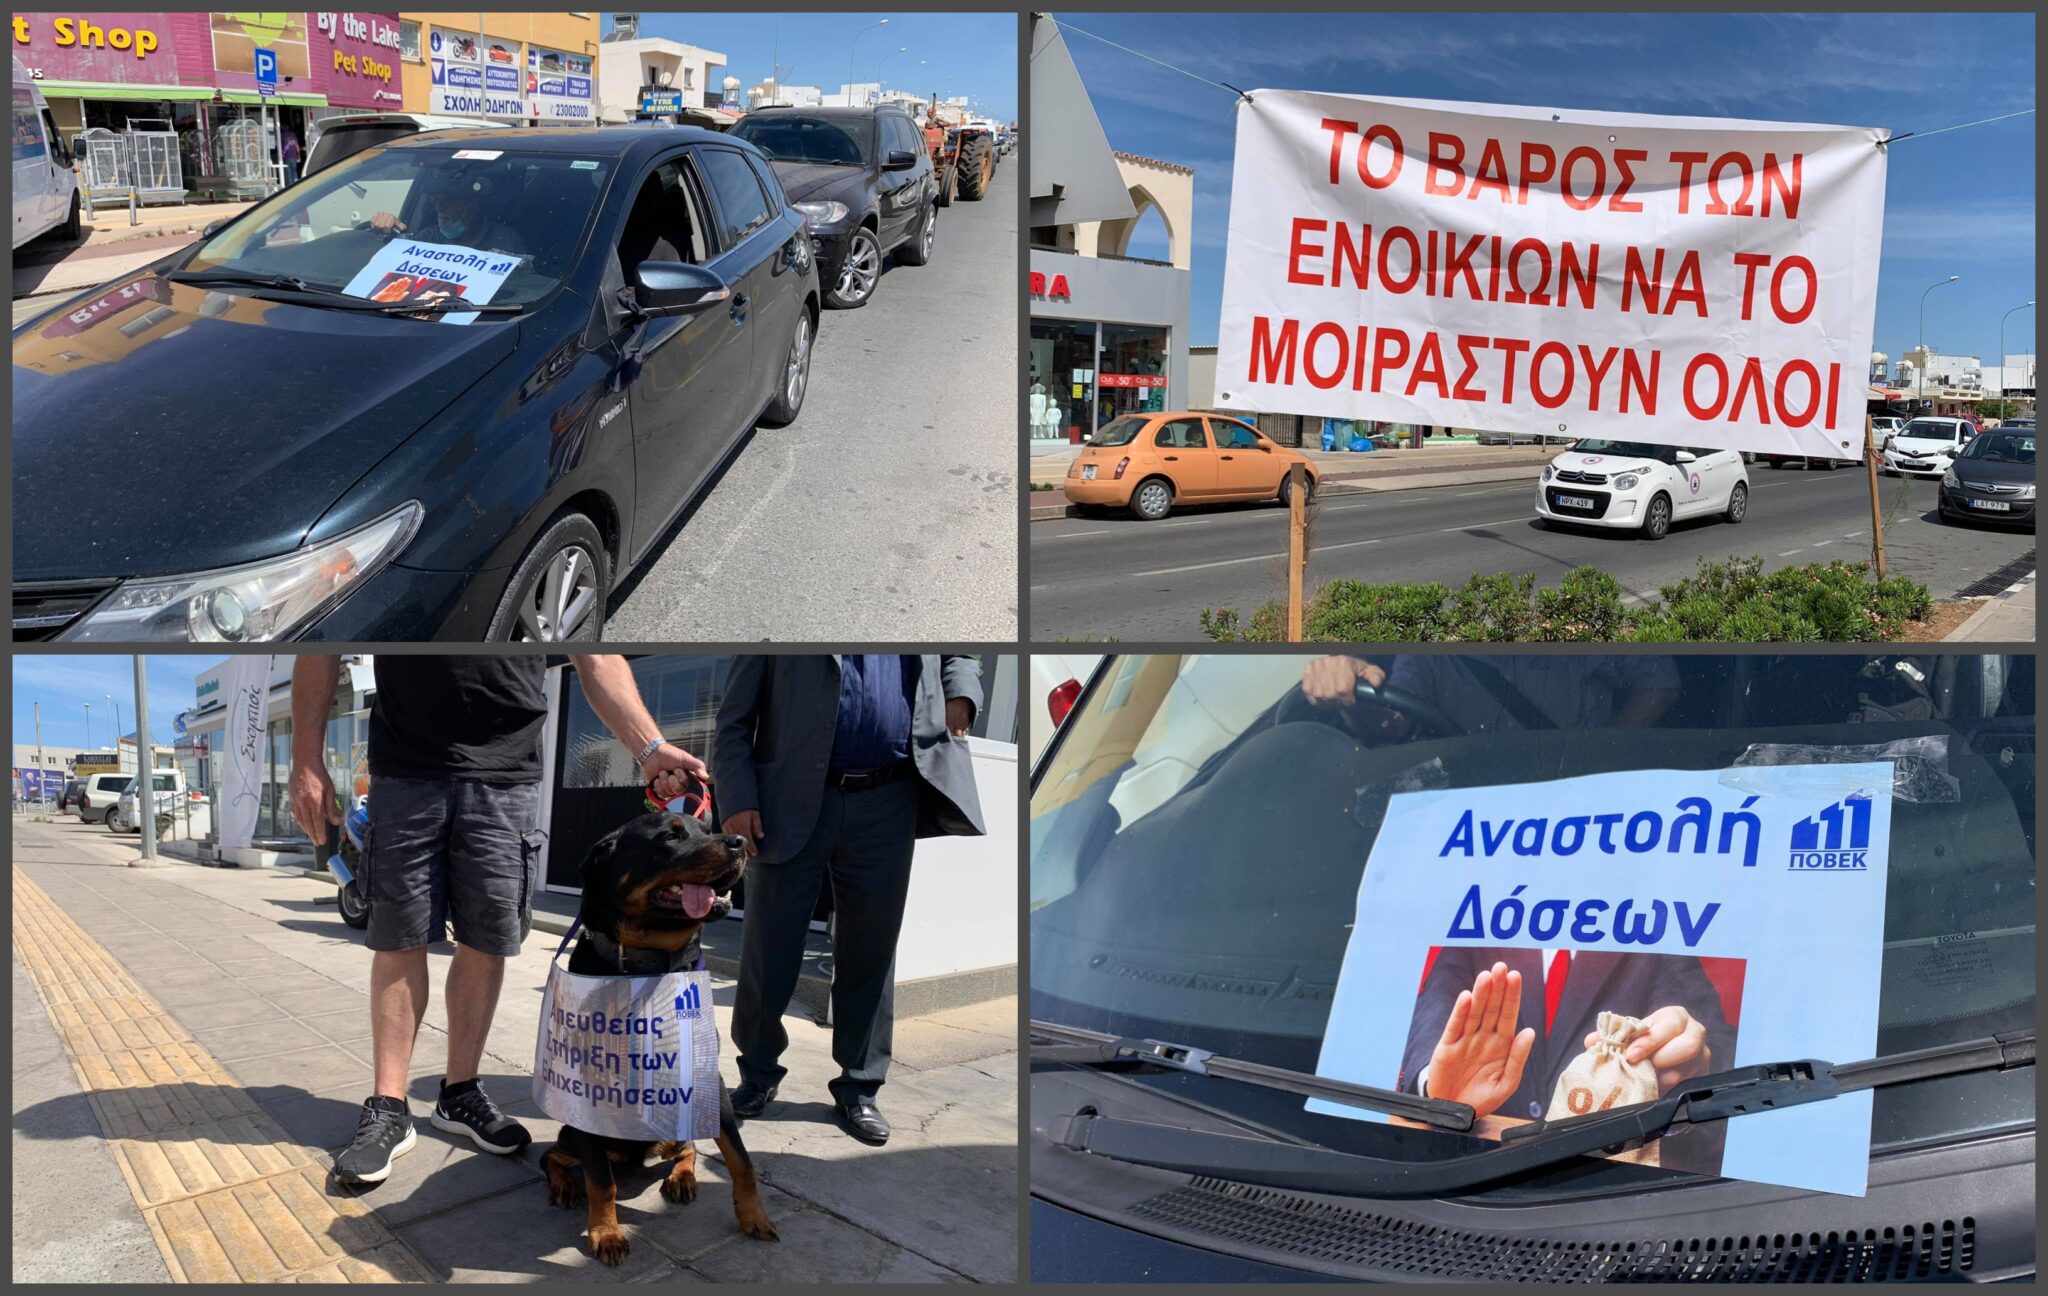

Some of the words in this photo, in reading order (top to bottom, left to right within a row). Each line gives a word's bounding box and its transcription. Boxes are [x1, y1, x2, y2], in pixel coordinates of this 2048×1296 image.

[54, 17, 158, 58] Shop
[317, 12, 337, 40] By
[343, 13, 367, 41] the
[372, 20, 400, 49] Lake
[258, 53, 274, 78] P
[334, 49, 357, 73] Pet
[362, 56, 392, 84] Shop
[444, 95, 481, 113] ΣΧΟΛΗ
[486, 98, 523, 115] ΟΔΗΓΩΝ
[555, 104, 589, 118] 23002000
[1320, 117, 1405, 191] ΤΟ
[1424, 131, 1649, 213] ΒΑΡΟΣ
[1669, 150, 1804, 220] ΤΩΝ
[394, 260, 469, 283] Δόσεων
[402, 245, 488, 271] Αναστολή
[1286, 216, 1601, 311] ΕΝΟΙΚΙΩΝ
[1620, 245, 1709, 319] ΝΑ
[1733, 251, 1819, 325] ΤΟ
[1247, 315, 1661, 417] ΜΟΙΡΑΣΤΟΥΝ
[1682, 352, 1841, 431] ΟΛΟΙ
[240, 684, 265, 763] Σκορπιός
[1438, 795, 1763, 868] Αναστολή
[1788, 852, 1868, 869] ΠΟΒΕΚ
[1445, 883, 1722, 948] Δόσεων
[1938, 931, 1976, 943] TOYOTA
[550, 1008, 664, 1039] Απευθείας
[675, 1010, 701, 1018] ΠΟΒΕΚ
[546, 1030, 621, 1075] Στήριξη
[628, 1051, 678, 1071] των
[542, 1058, 694, 1109] Επιχειρήσεων
